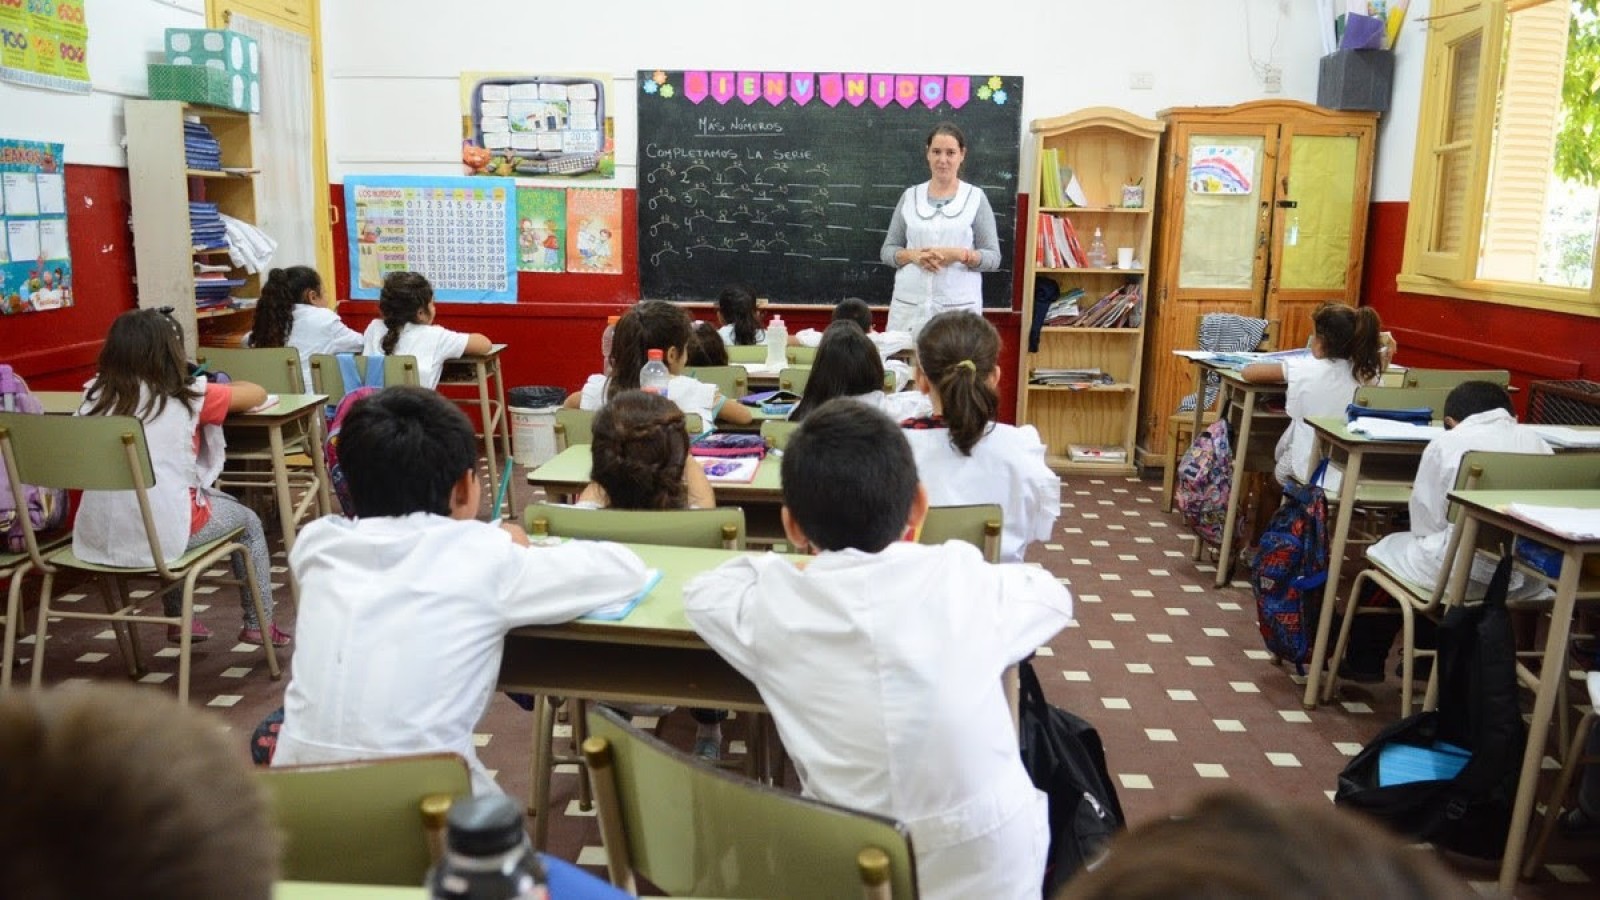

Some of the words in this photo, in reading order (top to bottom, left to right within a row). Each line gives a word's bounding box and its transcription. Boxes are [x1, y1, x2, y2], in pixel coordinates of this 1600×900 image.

[730, 117, 784, 132] NÚMEROS
[646, 143, 738, 160] COMPLETAMOS
[746, 147, 763, 160] LA
[773, 148, 813, 160] SERIE
[680, 171, 690, 184] 2
